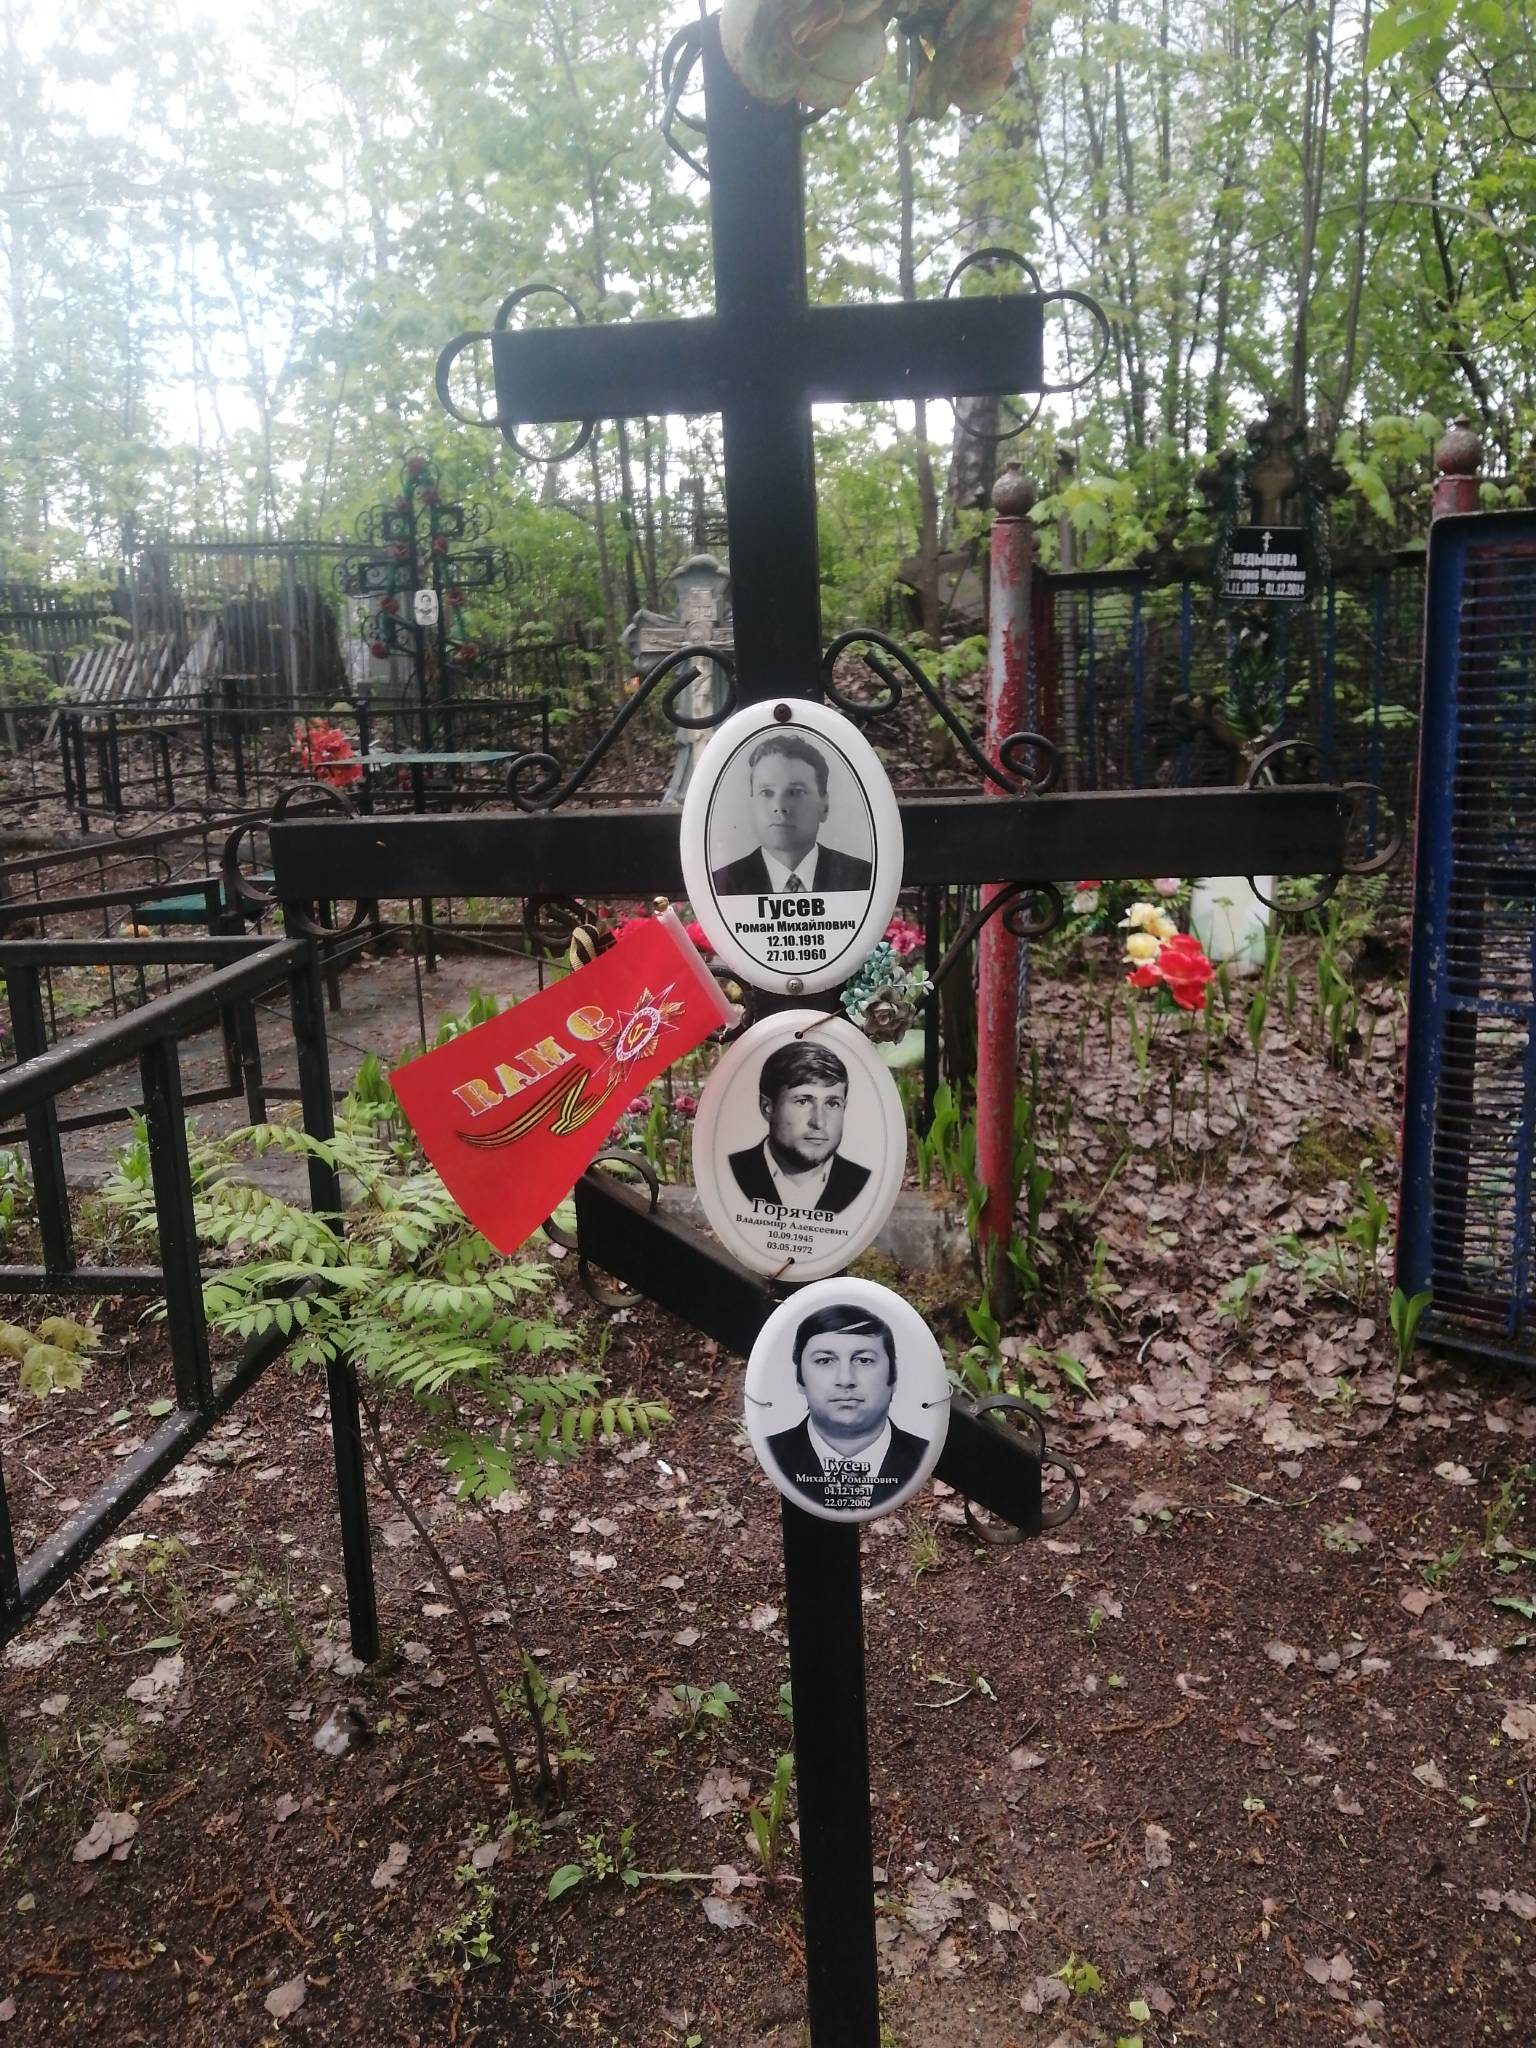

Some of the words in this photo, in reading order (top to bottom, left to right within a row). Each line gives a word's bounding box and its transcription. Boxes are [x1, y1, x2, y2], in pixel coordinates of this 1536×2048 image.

[757, 896, 826, 919] Гусев
[735, 922, 775, 934] Роман
[777, 919, 856, 932] Михайлович
[766, 934, 825, 947] 12.10.1918
[766, 948, 827, 961] 27.10.1960
[752, 1198, 834, 1223] Горячев
[735, 1214, 787, 1230] Владимир
[789, 1221, 849, 1236] Алексеевич
[767, 1230, 814, 1243] 10.09.1945
[766, 1241, 813, 1254] 03.05.1972
[823, 1457, 871, 1475] Гусев
[796, 1473, 837, 1484] Михаил
[841, 1474, 898, 1484] Романович
[824, 1486, 871, 1496] 04.12.1951
[824, 1498, 871, 1508] 22.07.2006
